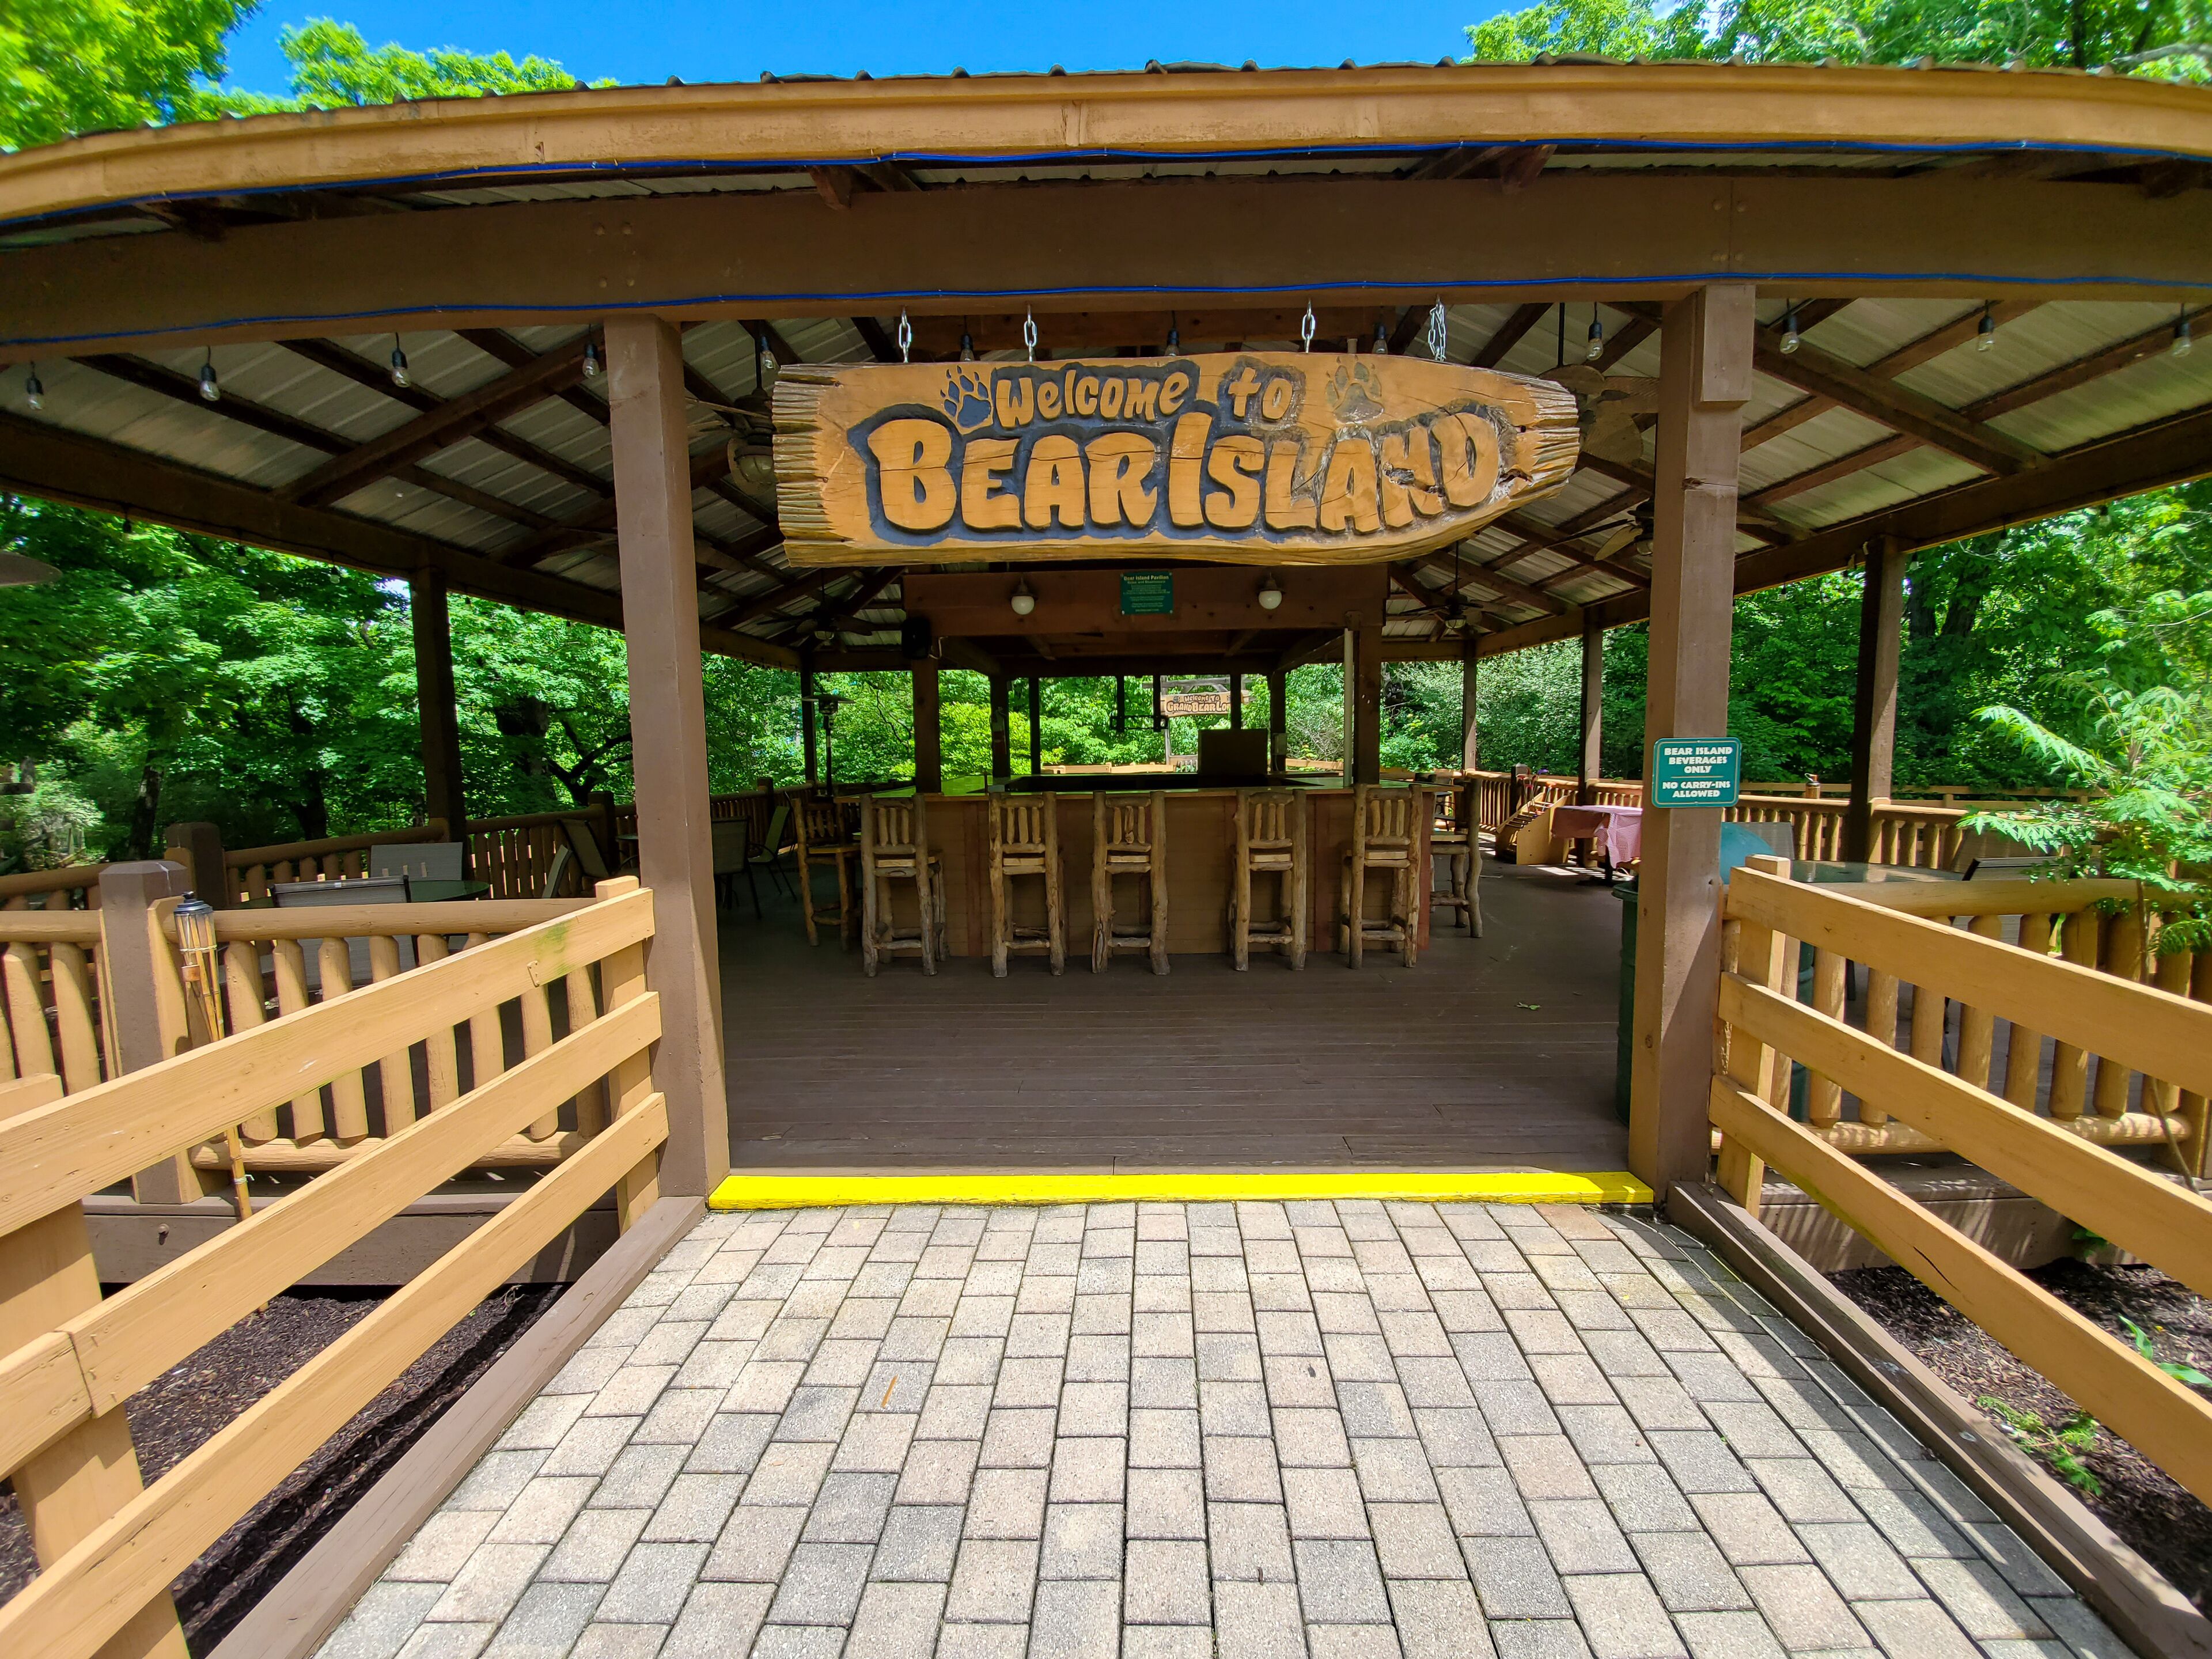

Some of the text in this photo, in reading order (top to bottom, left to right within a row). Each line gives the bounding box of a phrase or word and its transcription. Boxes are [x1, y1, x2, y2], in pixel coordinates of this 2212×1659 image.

[995, 367, 1293, 427] Welcome to
[1695, 747, 1733, 755] ISLAND
[1668, 756, 1728, 765] BEVERAGES
[1684, 766, 1712, 774] ONLY
[1680, 781, 1731, 789] CARRY-INS
[1672, 790, 1721, 798] ALLOWED
